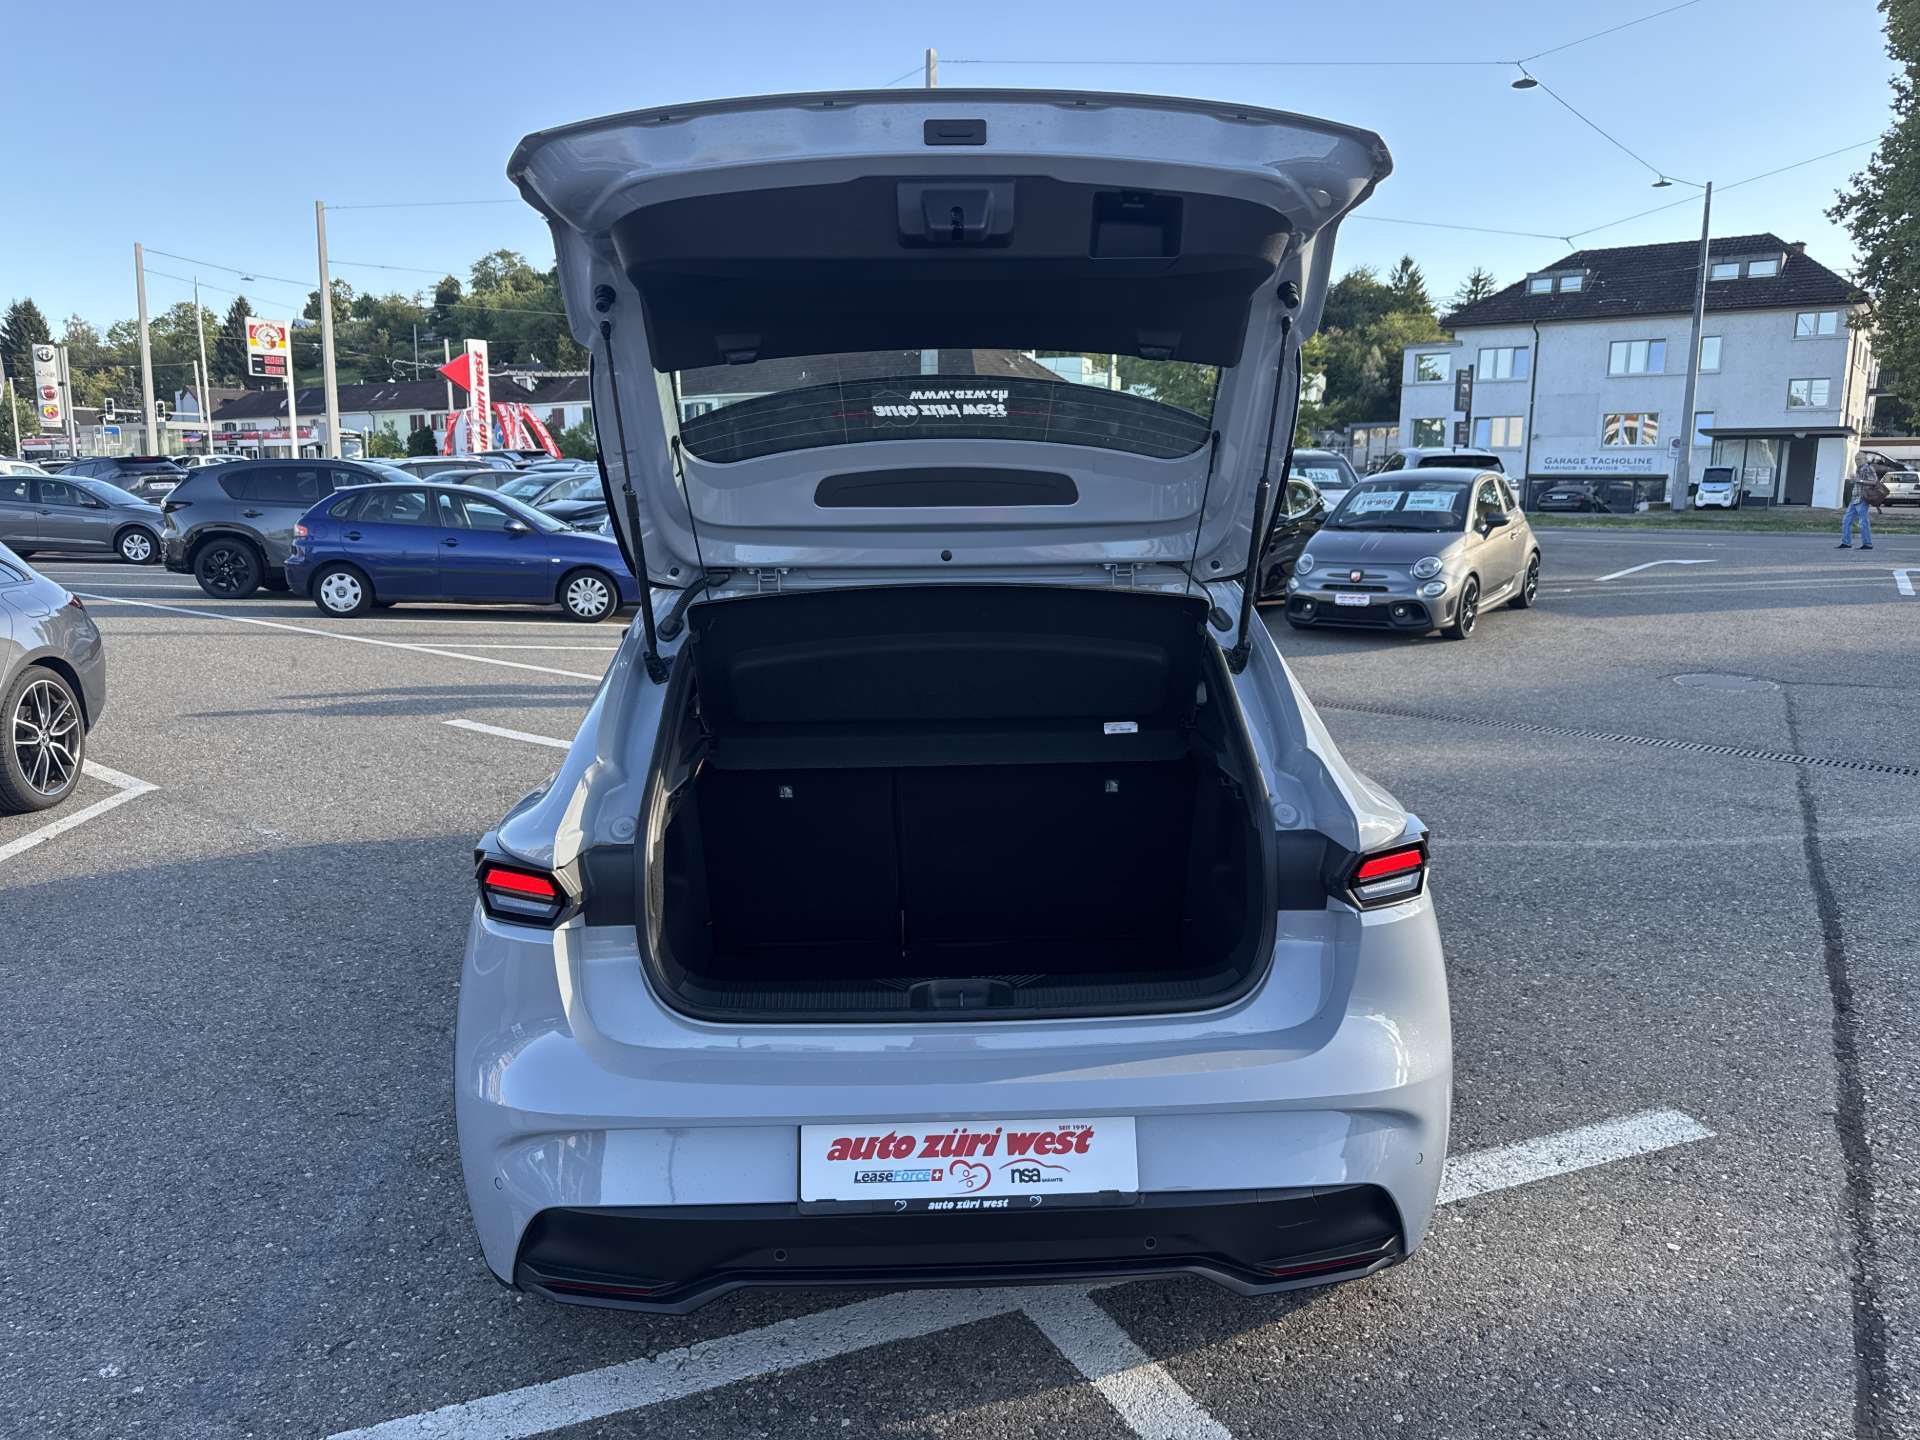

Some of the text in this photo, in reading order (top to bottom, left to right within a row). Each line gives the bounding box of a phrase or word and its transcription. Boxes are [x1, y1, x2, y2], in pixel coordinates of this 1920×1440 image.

[474, 351, 485, 387] west
[827, 1125, 1094, 1161] auto züri west
[1010, 1167, 1041, 1183] nsa
[928, 1198, 1009, 1210] auto züri west
